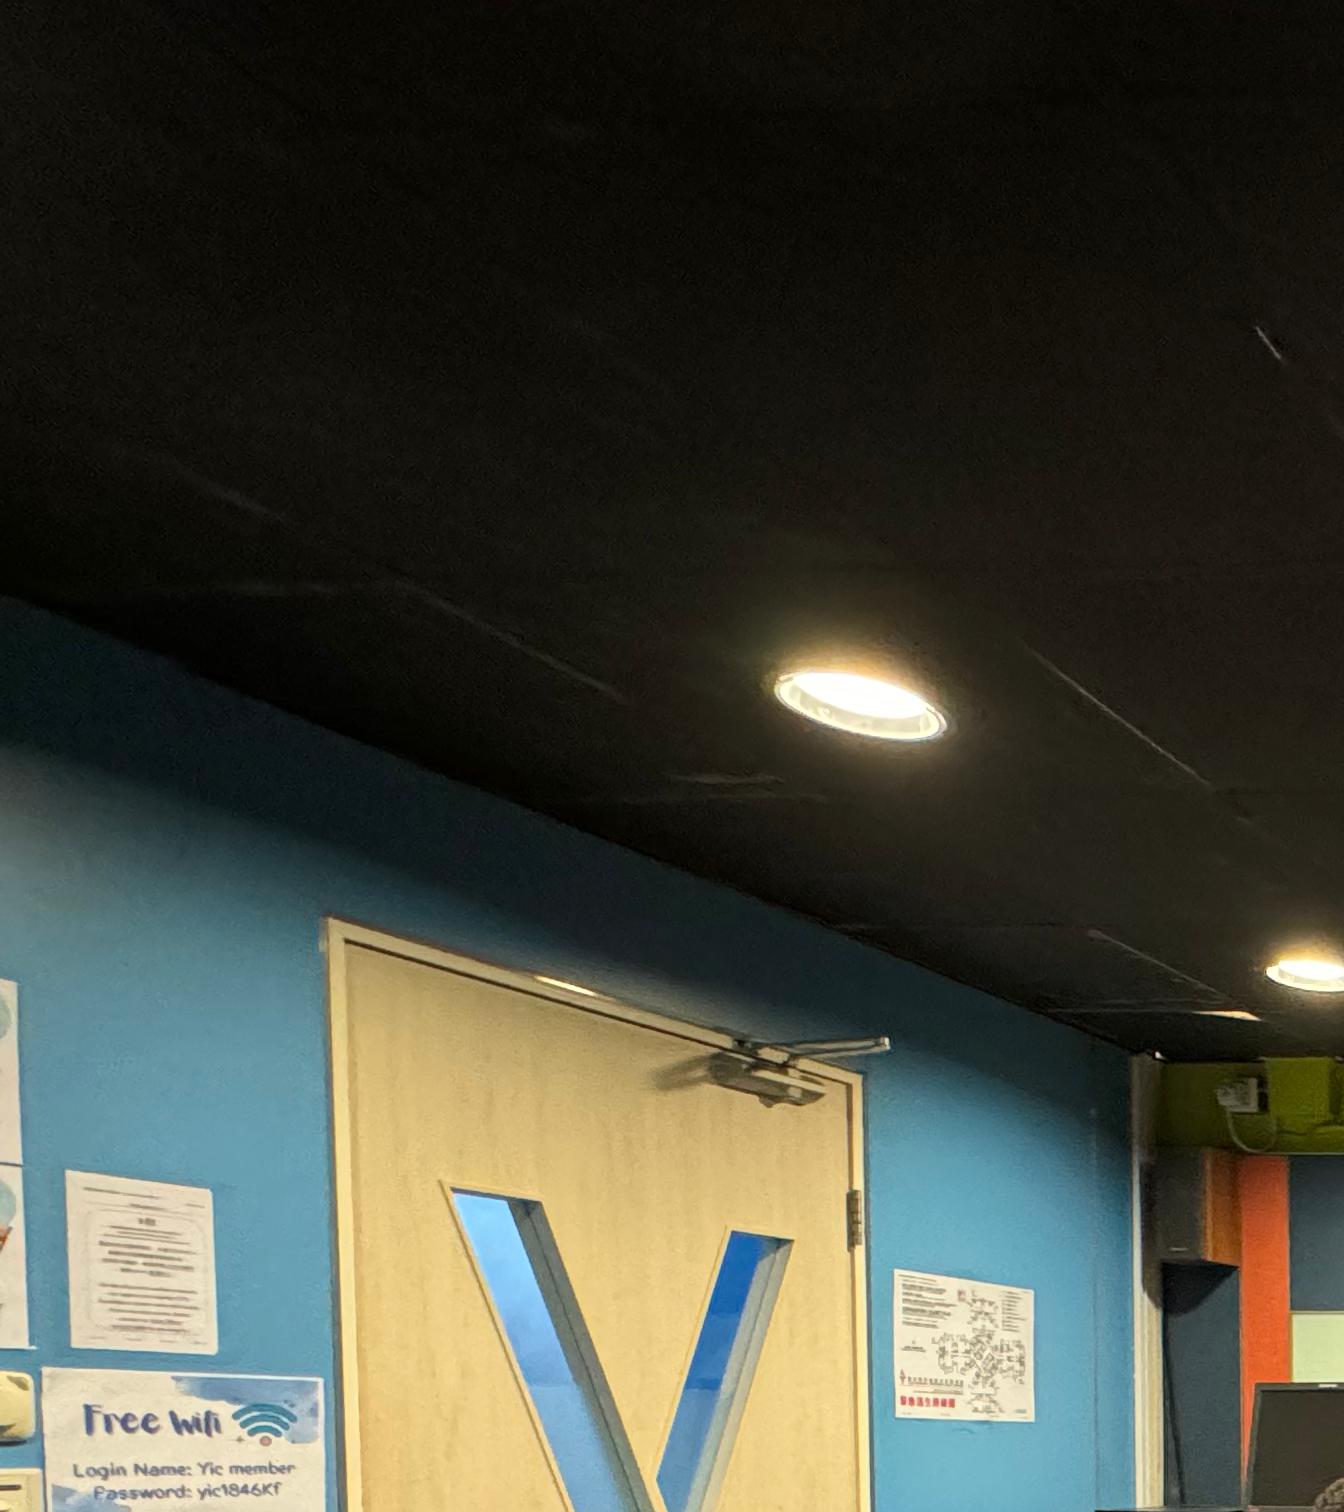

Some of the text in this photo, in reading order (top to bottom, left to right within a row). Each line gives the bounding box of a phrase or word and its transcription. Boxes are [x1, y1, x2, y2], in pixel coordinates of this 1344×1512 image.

[83, 1403, 161, 1436] Free
[73, 1461, 296, 1480] Login Name: Yic member
[93, 1485, 192, 1500] Password:
